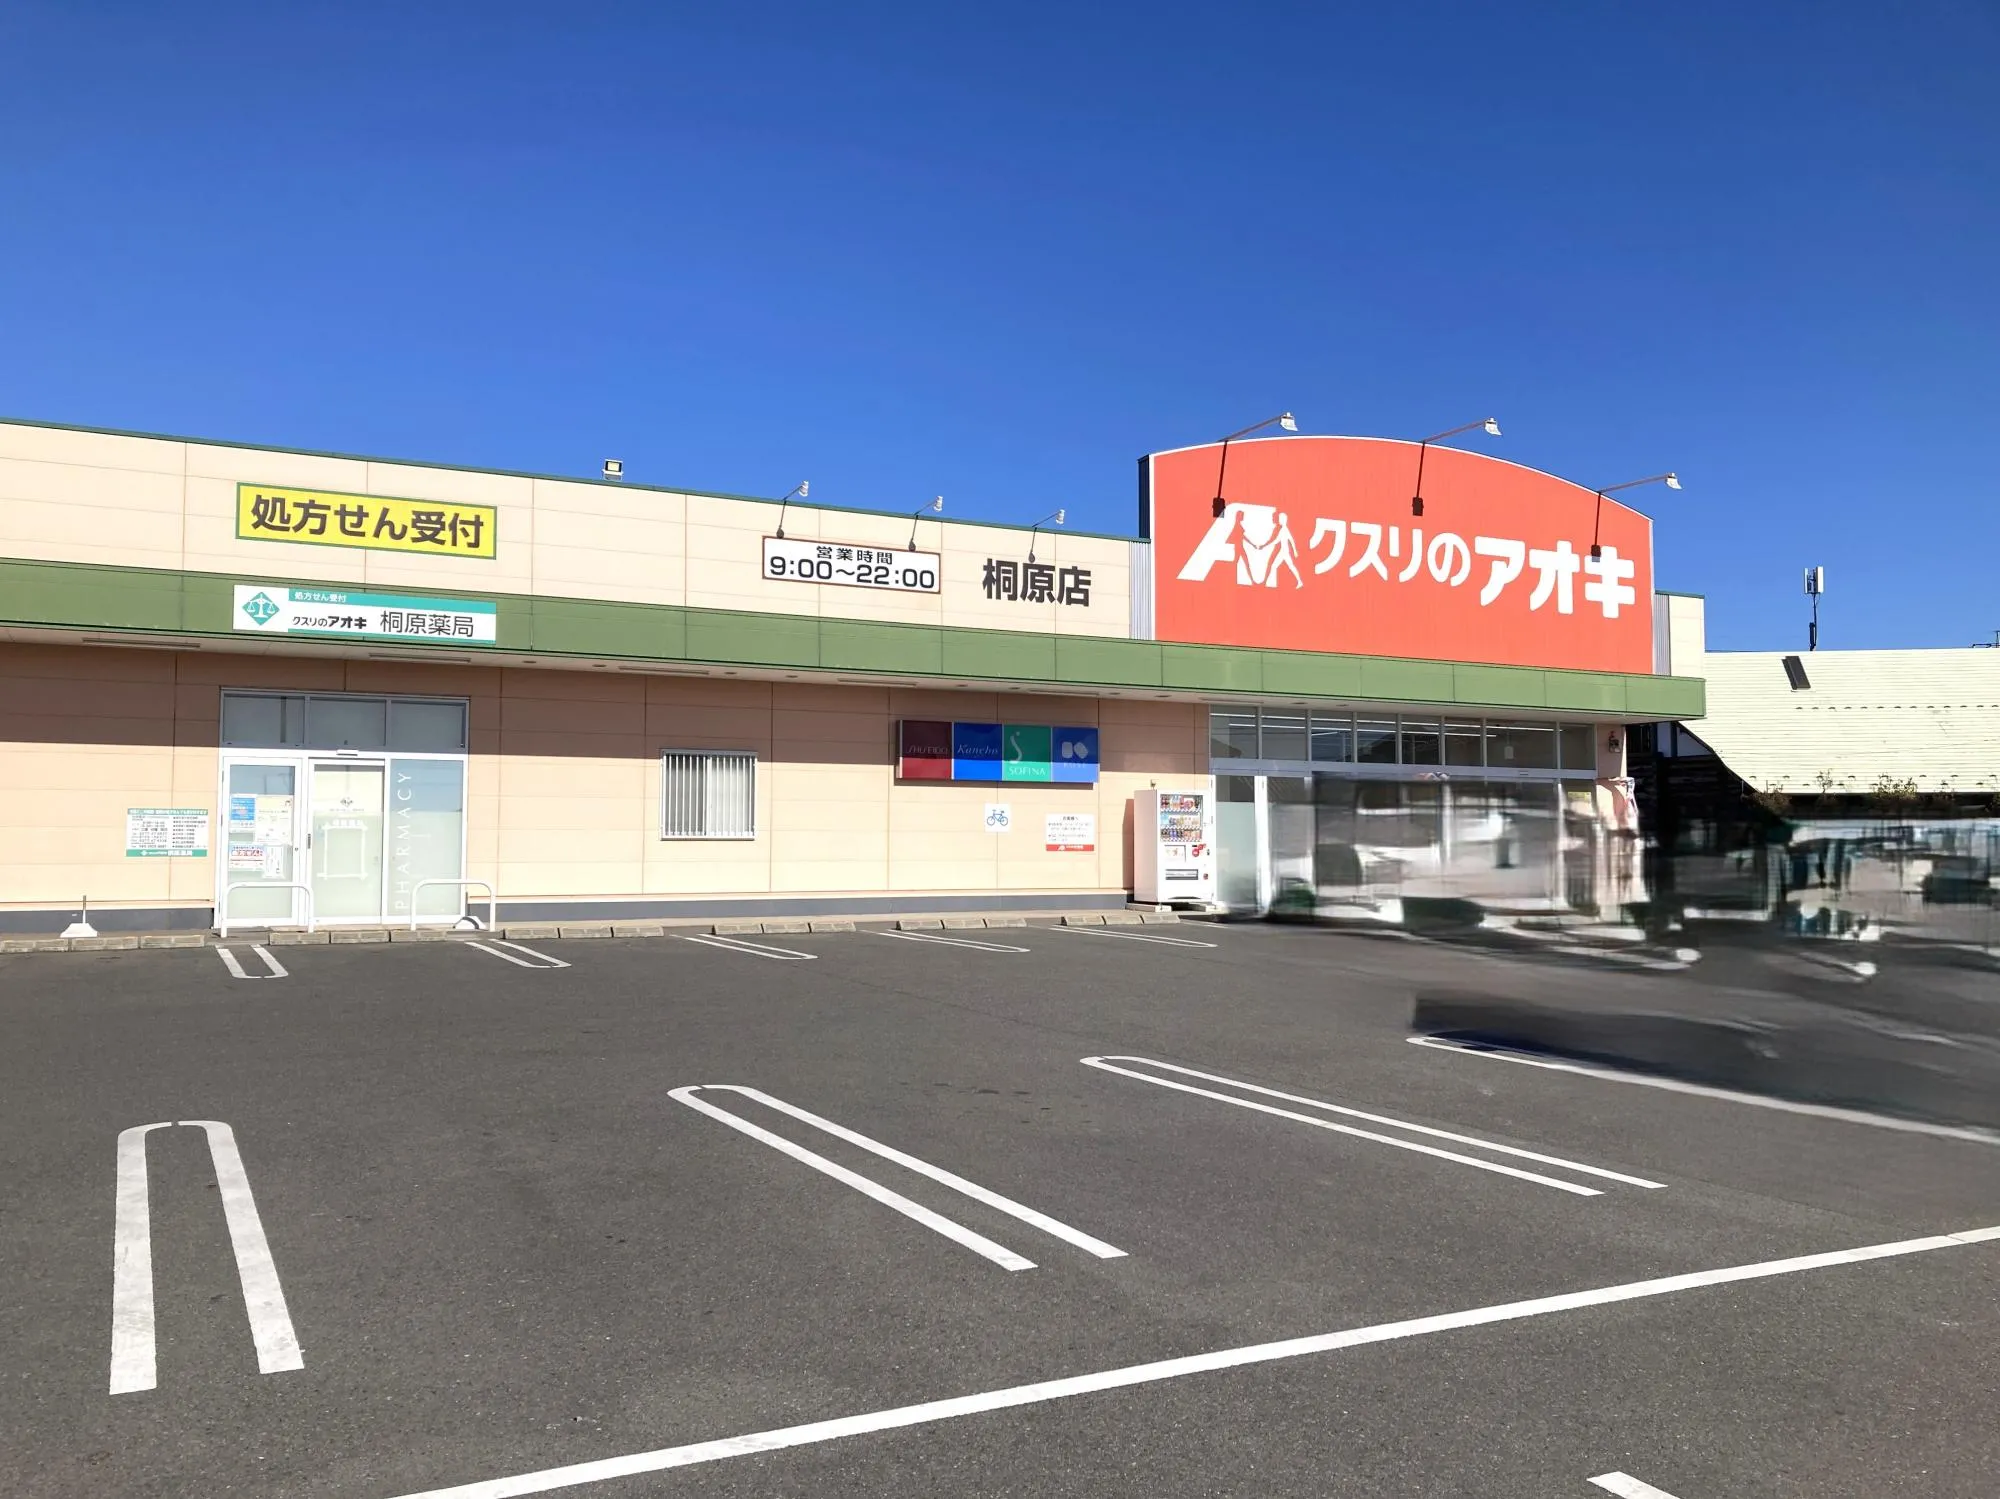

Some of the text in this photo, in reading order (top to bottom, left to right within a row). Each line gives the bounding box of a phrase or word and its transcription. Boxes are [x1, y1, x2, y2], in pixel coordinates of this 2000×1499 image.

[251, 494, 485, 549] 処方せん受付
[816, 545, 894, 566] 営業時間
[1309, 516, 1635, 619] クスリのアオキ
[294, 591, 347, 603] 処方せん受付
[982, 558, 1092, 607] 桐原店
[292, 610, 475, 638] クスリのアオキ 桐原薬局
[1008, 766, 1047, 776] SOFINA
[395, 771, 413, 911] PHARMACY
